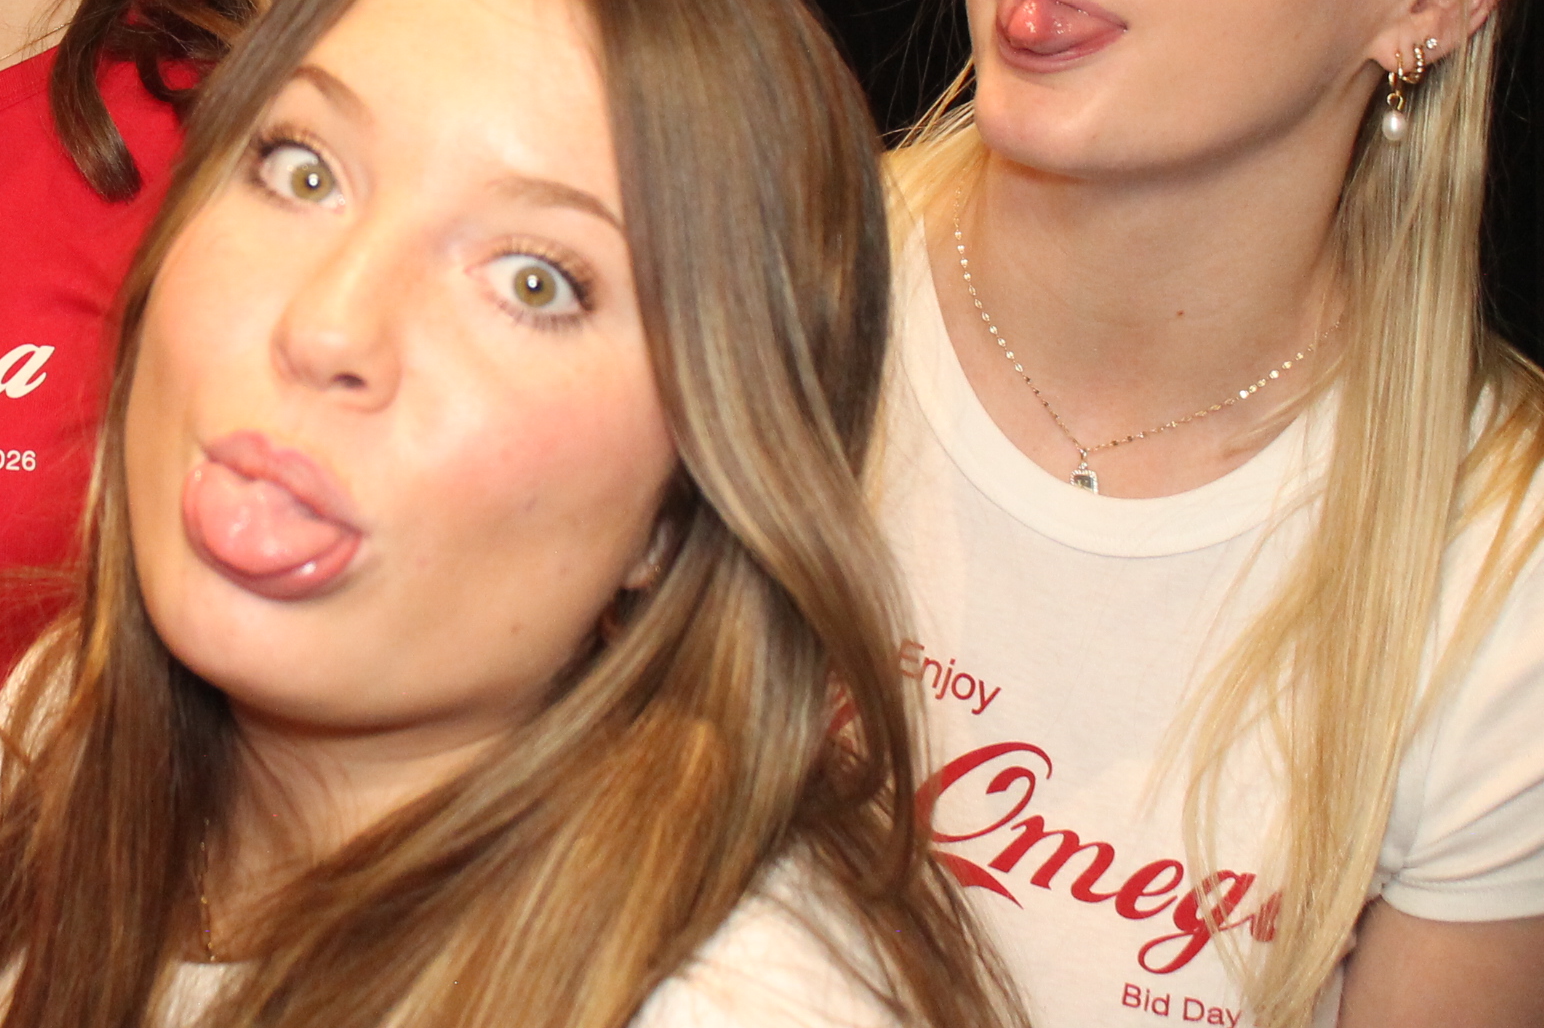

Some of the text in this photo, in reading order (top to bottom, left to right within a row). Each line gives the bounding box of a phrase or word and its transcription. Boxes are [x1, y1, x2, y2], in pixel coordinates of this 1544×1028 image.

[899, 638, 1002, 715] Enjoy
[1121, 982, 1243, 1028] Bid Day
